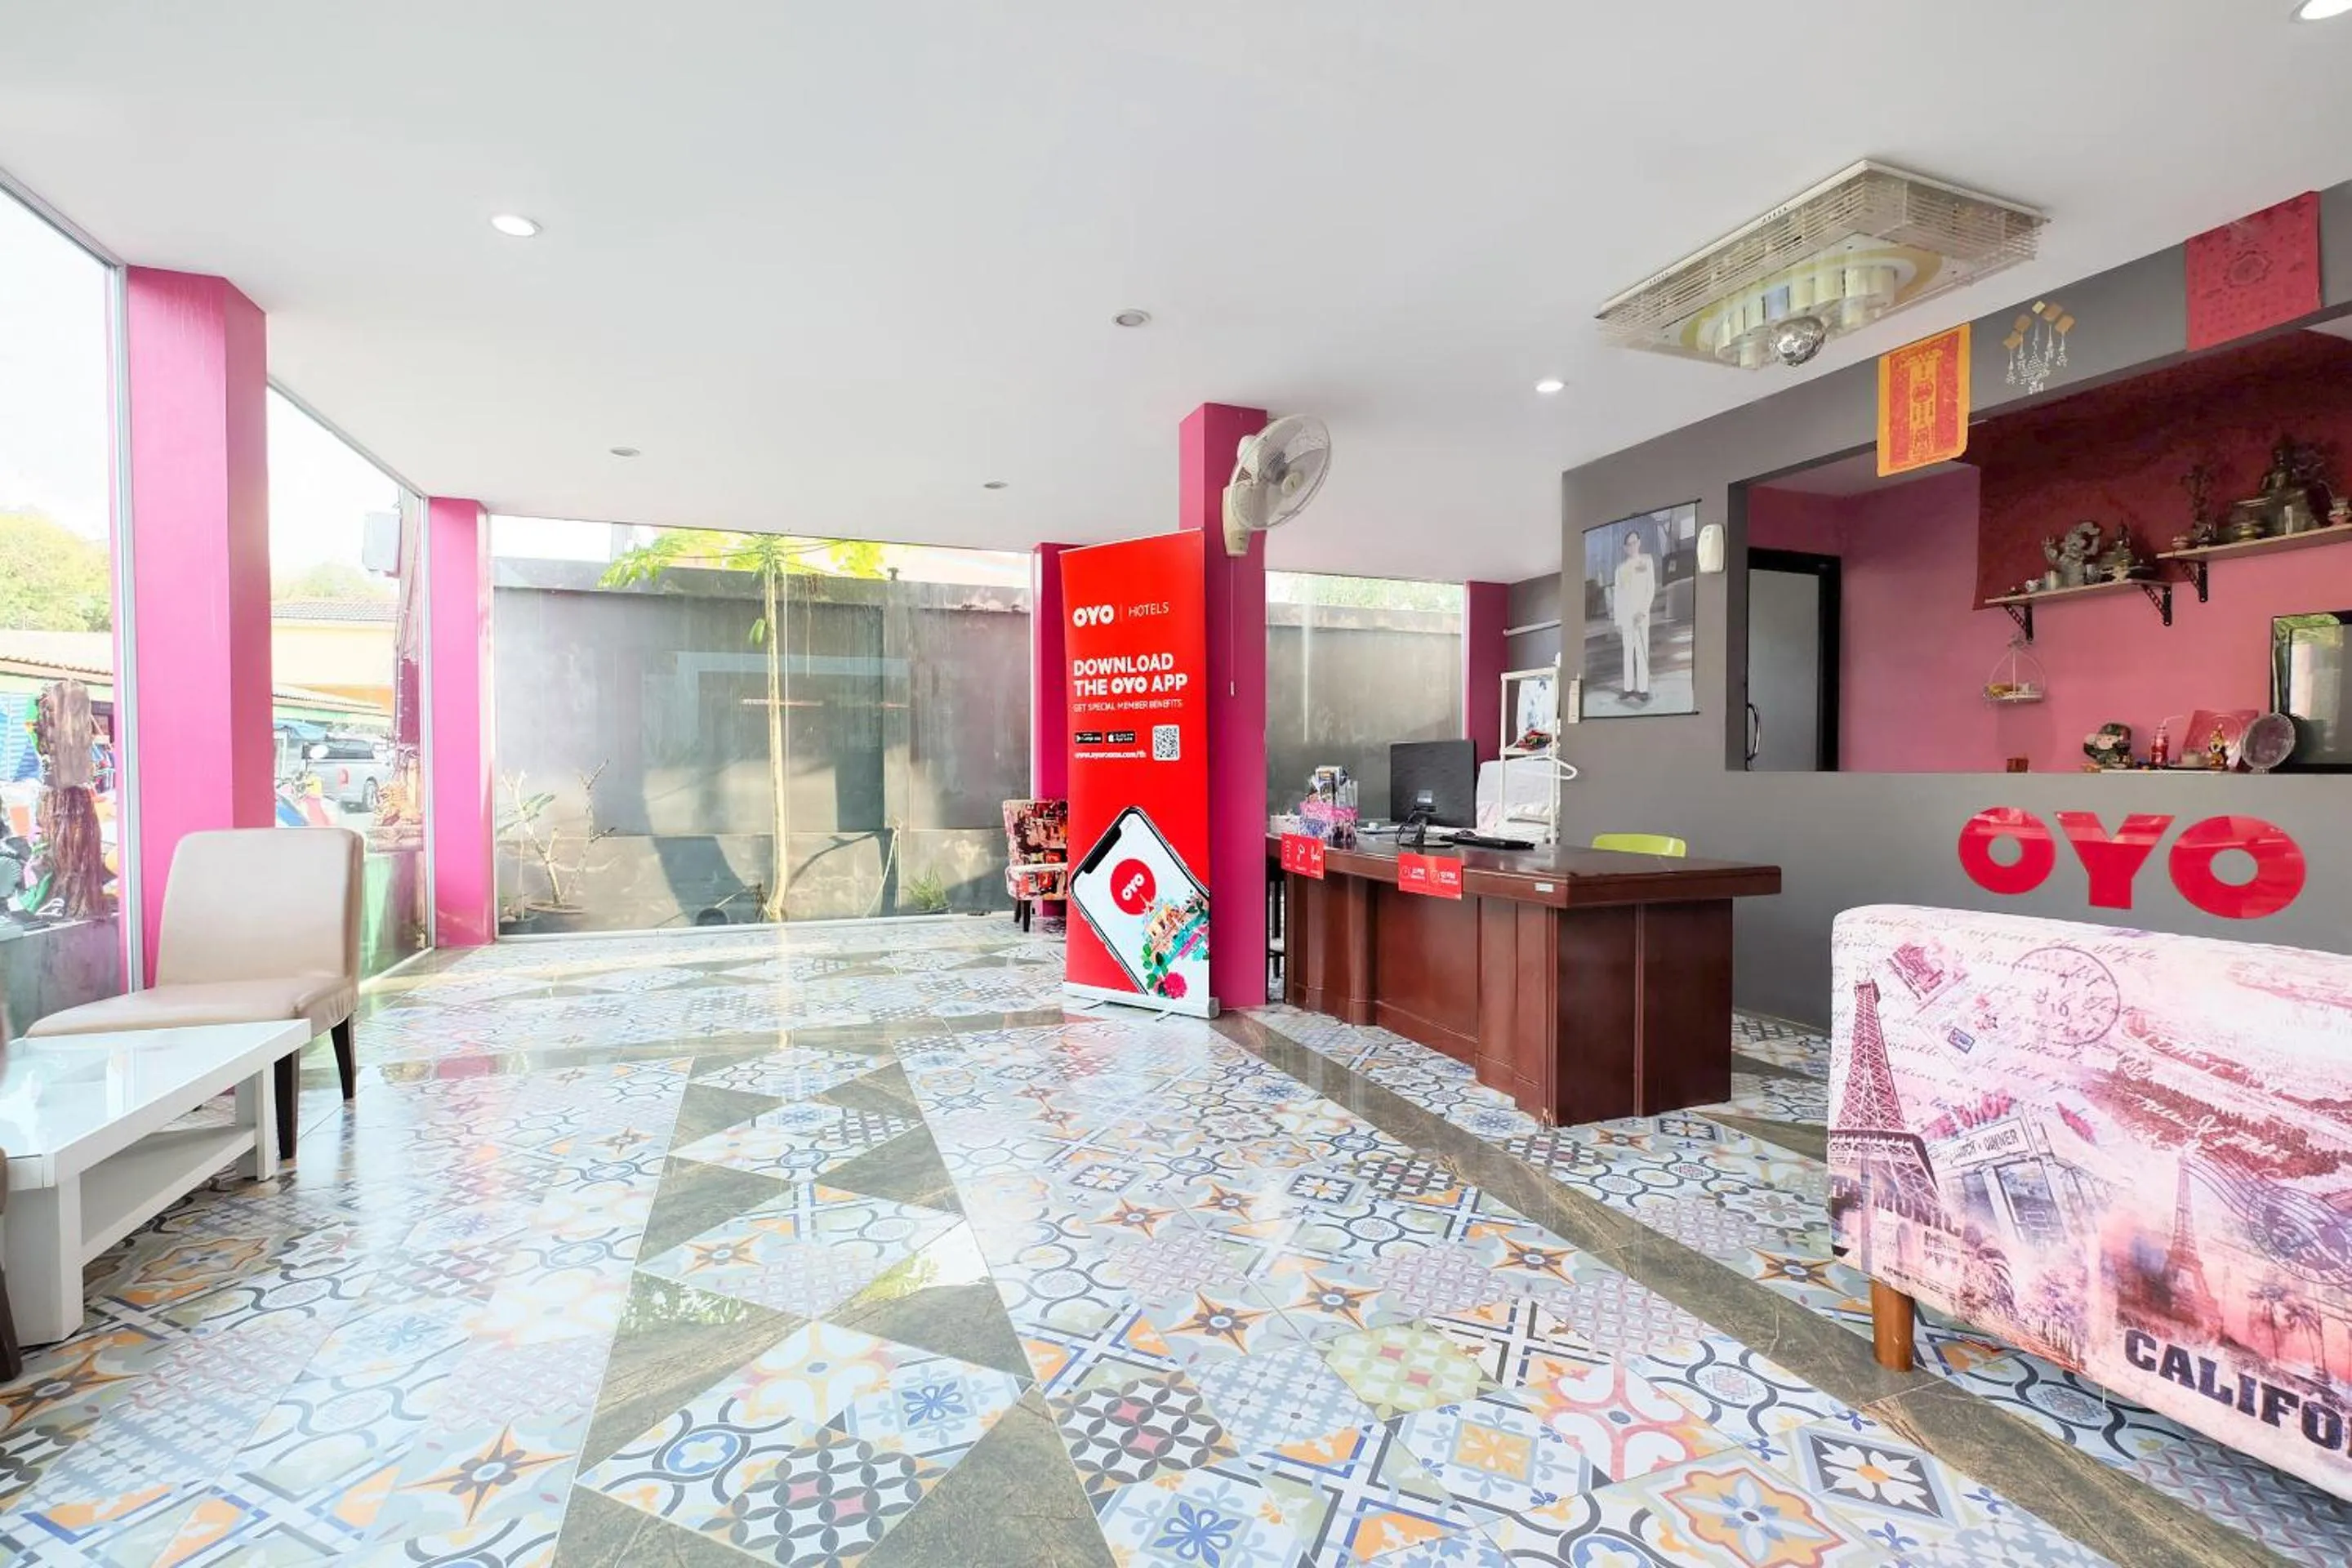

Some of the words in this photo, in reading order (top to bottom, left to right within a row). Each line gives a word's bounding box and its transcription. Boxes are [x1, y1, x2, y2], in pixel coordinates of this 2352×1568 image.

[1072, 604, 1114, 627] OYO
[1128, 602, 1169, 617] HOTELS
[1073, 653, 1174, 677] DOWNLOAD
[1073, 679, 1107, 697] THE
[1111, 675, 1147, 694] OYO
[1151, 673, 1187, 693] APP
[1088, 702, 1115, 711] SPECIAL
[1117, 701, 1148, 710] MEMBER
[1149, 698, 1183, 709] BENEFITS
[1958, 806, 2307, 920] OYO
[1121, 872, 1145, 901] OYO
[2124, 1329, 2352, 1459] CALIFO
